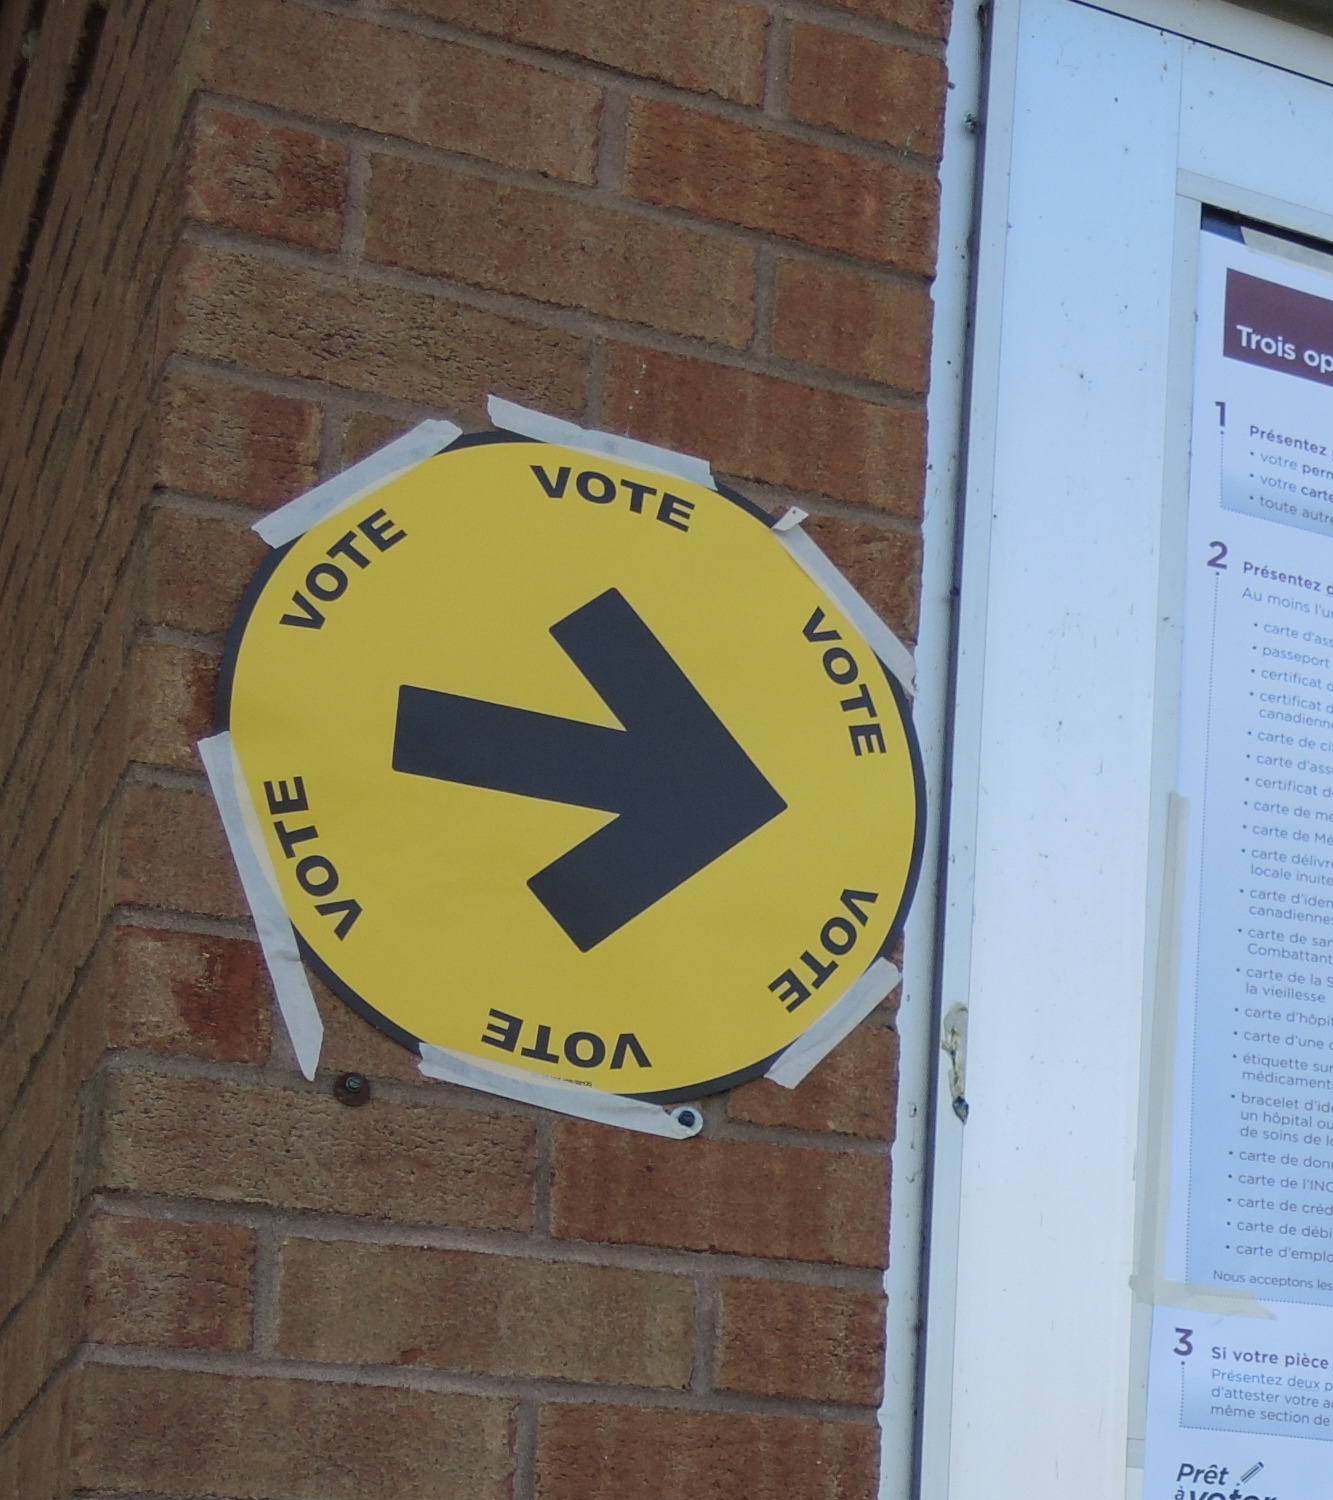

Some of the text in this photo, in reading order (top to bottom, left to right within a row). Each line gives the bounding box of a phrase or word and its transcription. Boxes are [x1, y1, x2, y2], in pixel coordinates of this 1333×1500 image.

[1235, 324, 1296, 360] Trois
[1214, 400, 1226, 427] 1
[1249, 424, 1327, 457] Présentez
[1260, 453, 1298, 471] votre
[1259, 475, 1297, 493] votre
[530, 465, 695, 533] VOTE
[1206, 540, 1228, 570] 2
[279, 509, 408, 631] VOTE
[1242, 560, 1321, 592] Présentez
[1262, 623, 1299, 639] carte
[1261, 646, 1330, 669] passeport
[802, 608, 887, 757] VOTE
[1252, 824, 1288, 839] carte
[1292, 828, 1310, 843] de
[263, 775, 363, 942] VOTE
[767, 888, 879, 1013] VOTE
[1244, 1007, 1282, 1021] carte
[480, 1008, 652, 1070] VOTE
[1235, 1244, 1274, 1257] carte
[1172, 1326, 1193, 1356] 3
[1211, 1345, 1226, 1360] Si
[1232, 1349, 1279, 1365] votre
[1284, 1354, 1329, 1370] pièce
[1175, 1462, 1230, 1486] Prêt
[1174, 1485, 1185, 1500] à
